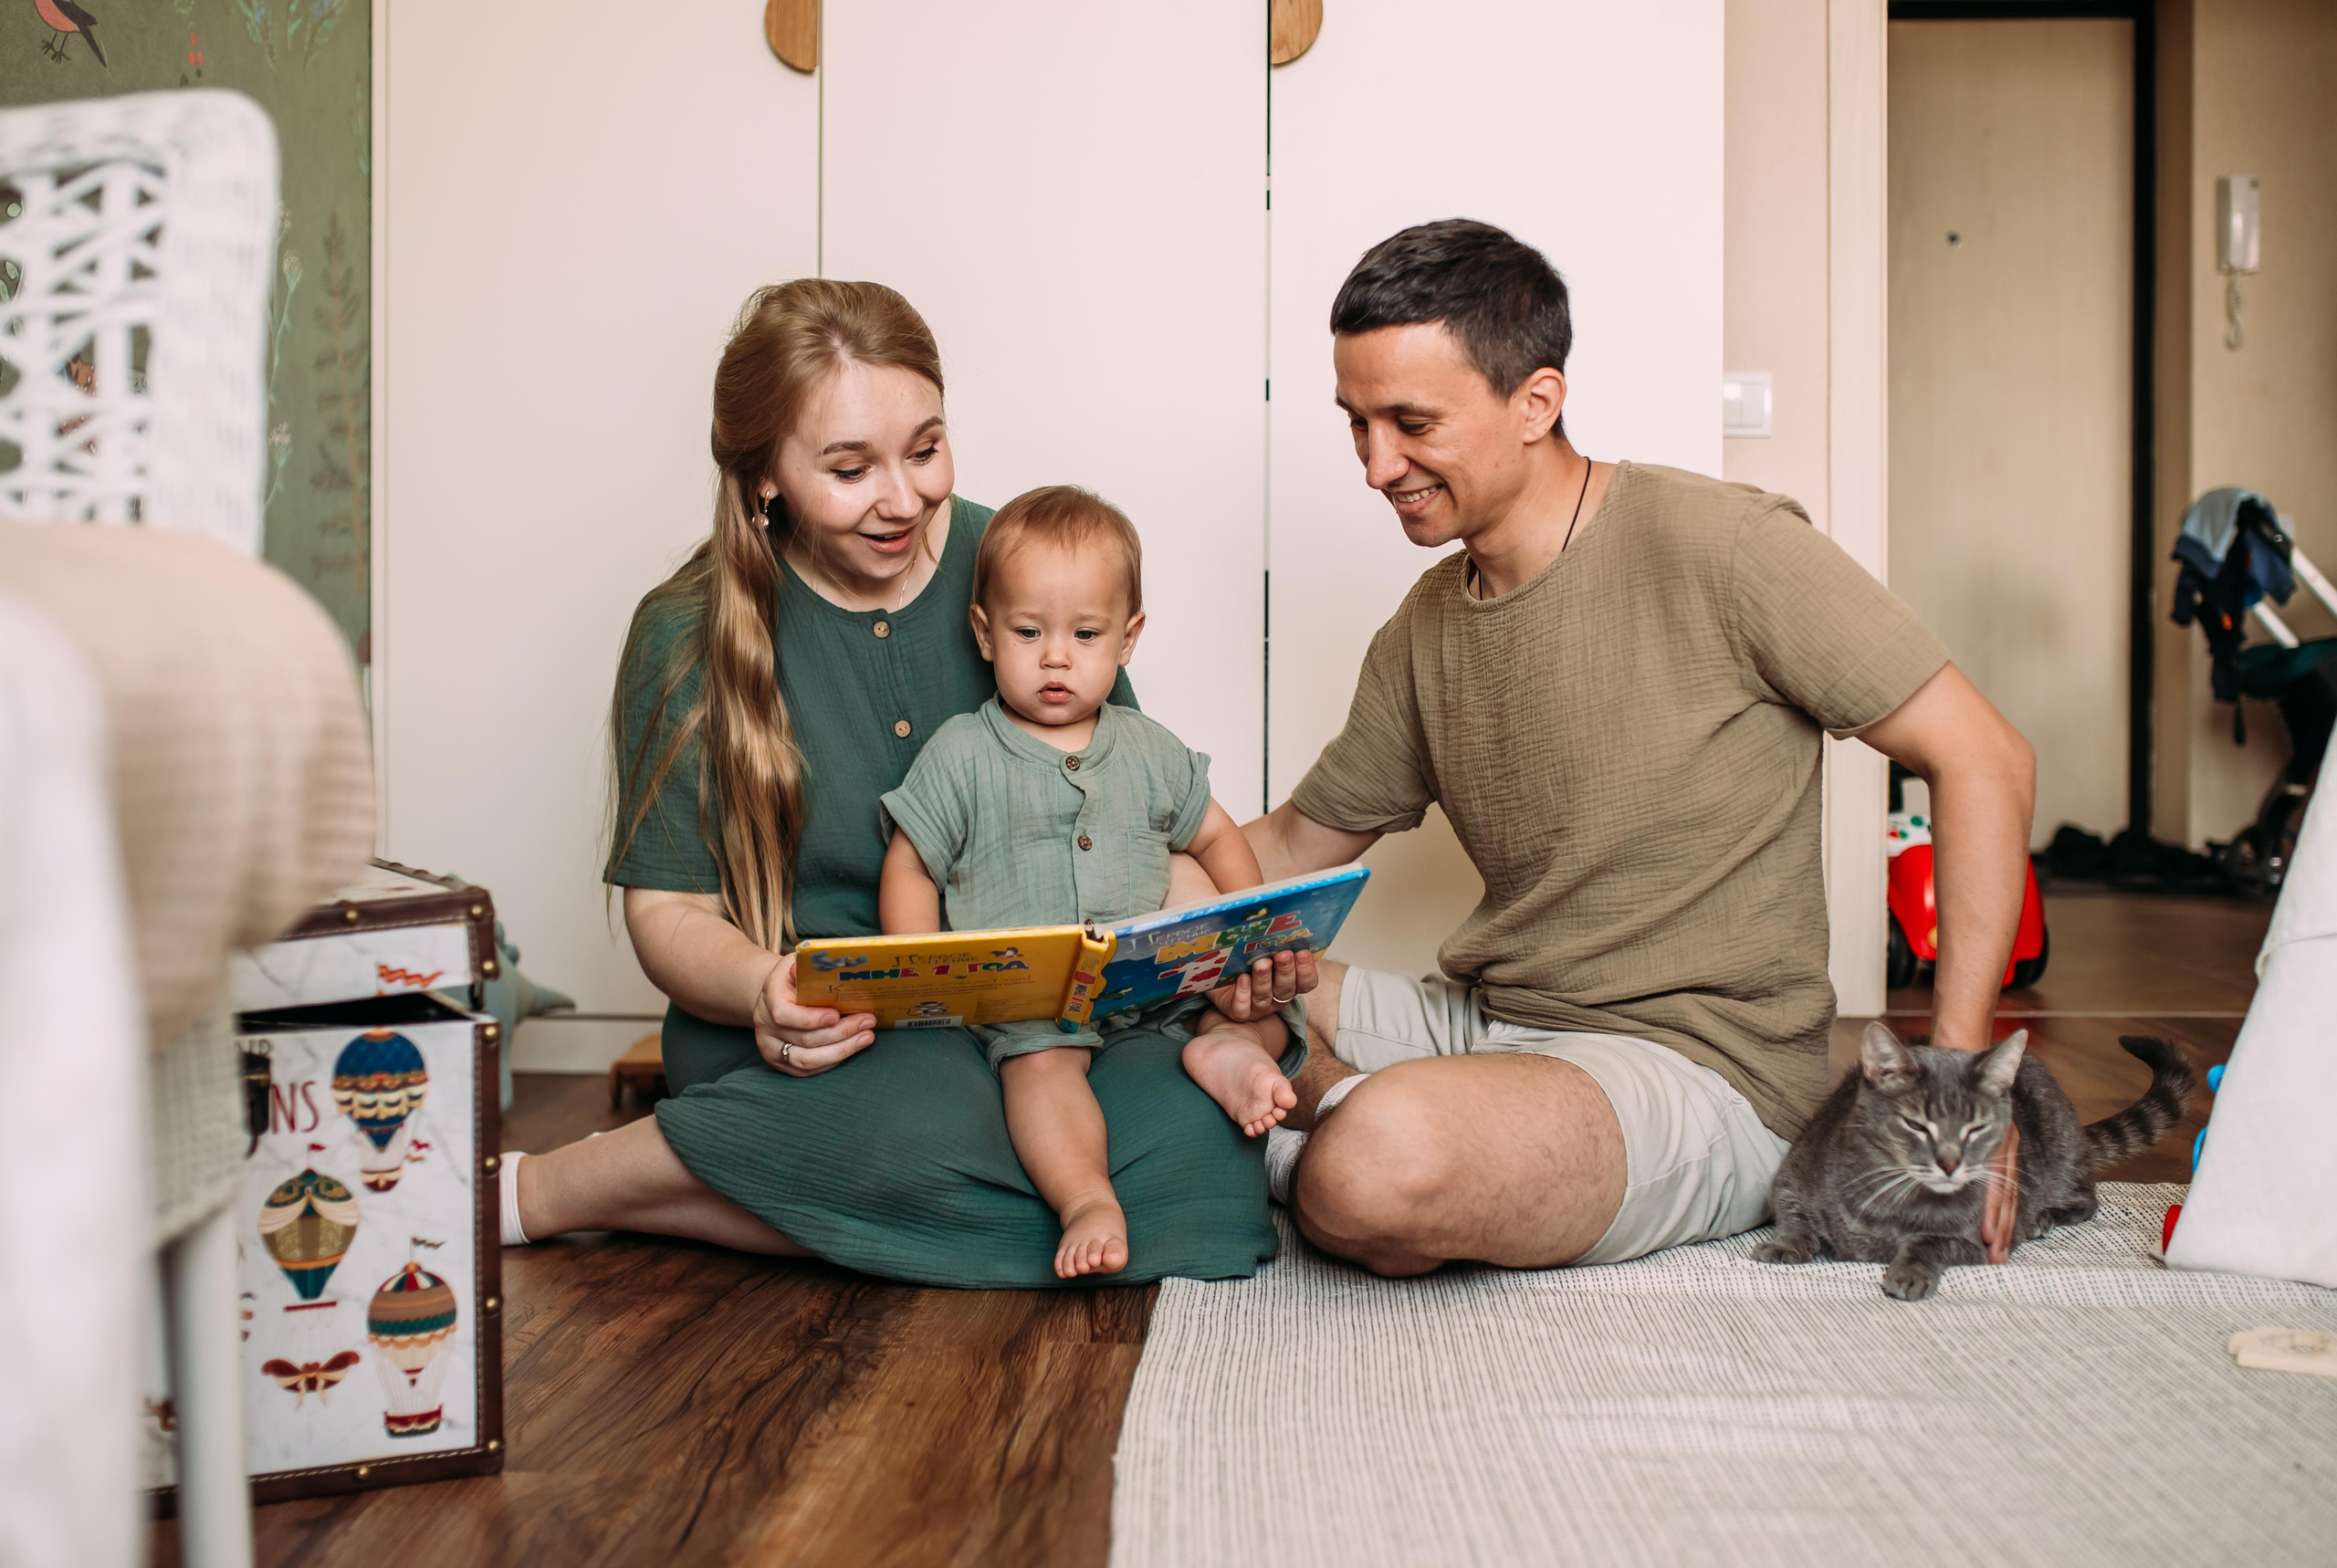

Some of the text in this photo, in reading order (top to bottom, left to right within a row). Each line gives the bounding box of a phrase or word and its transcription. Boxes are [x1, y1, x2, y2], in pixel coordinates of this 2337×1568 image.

[1155, 911, 1303, 965] МНЕ
[838, 960, 1030, 981] МНЕ 1 ГОД
